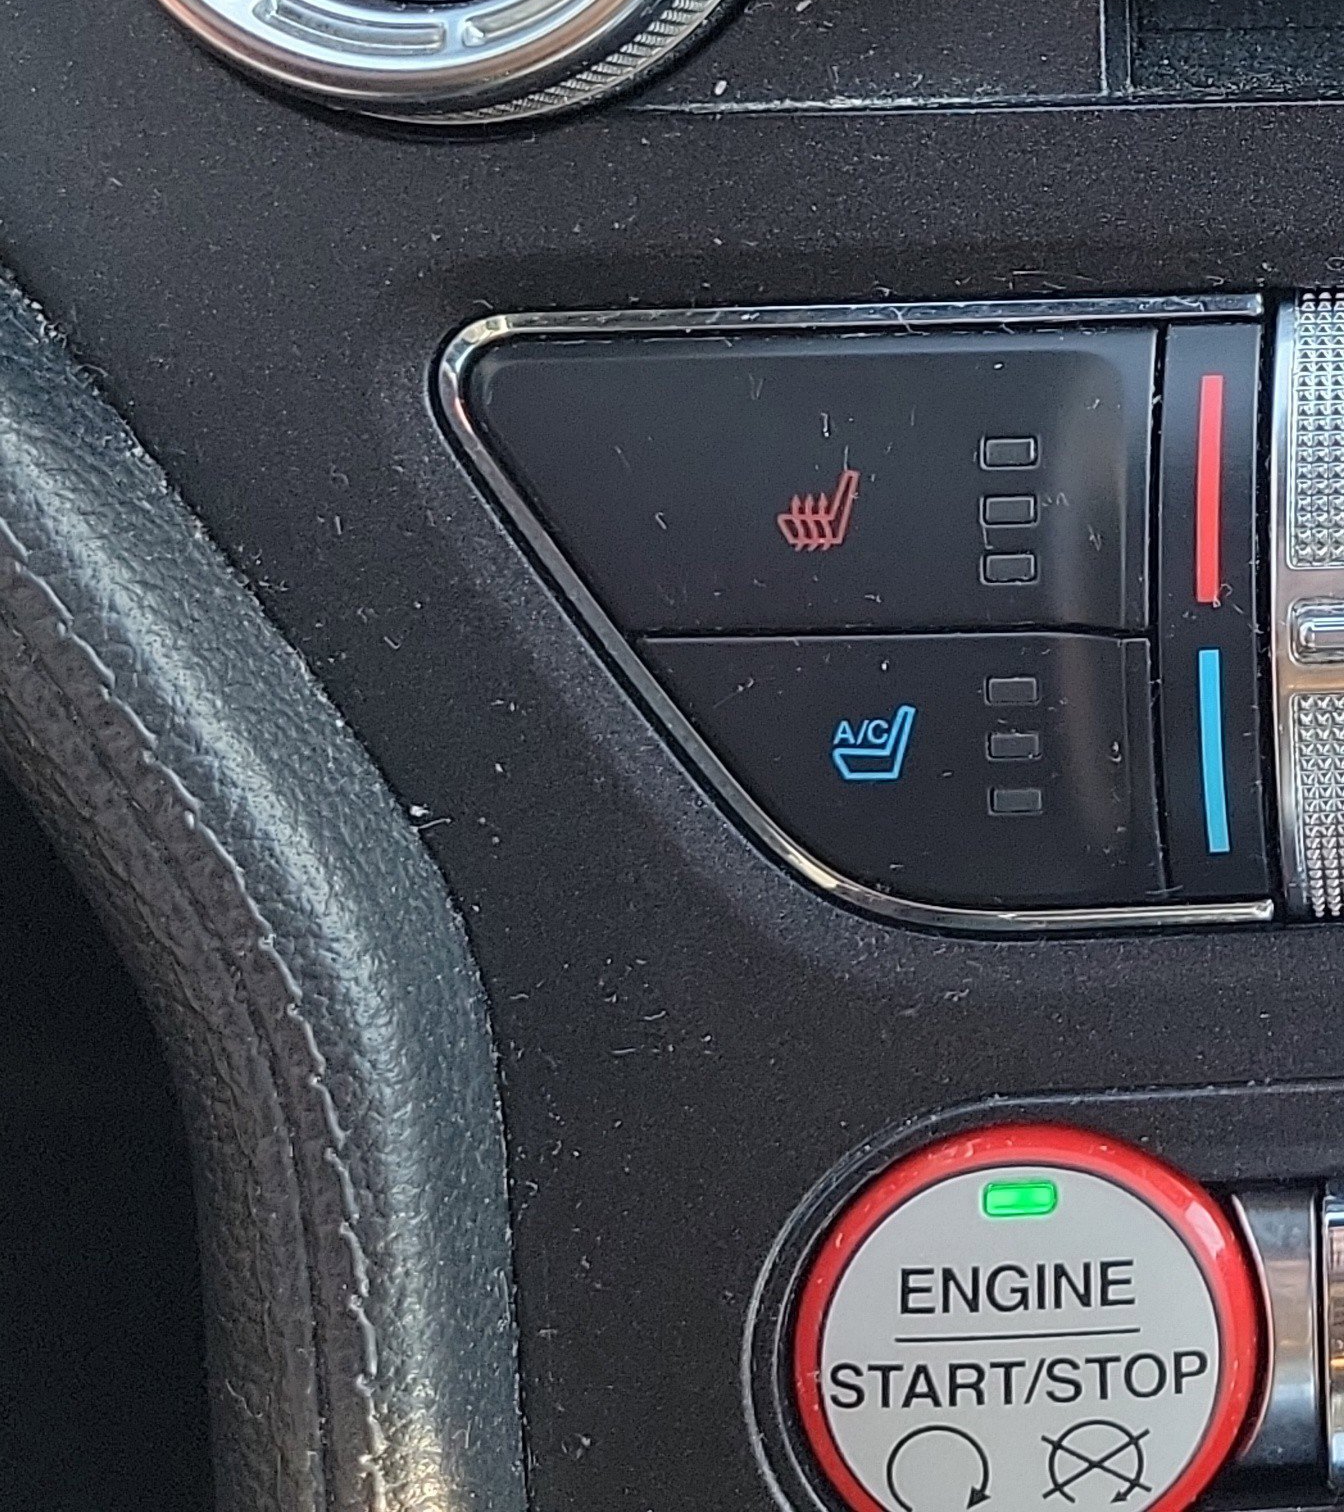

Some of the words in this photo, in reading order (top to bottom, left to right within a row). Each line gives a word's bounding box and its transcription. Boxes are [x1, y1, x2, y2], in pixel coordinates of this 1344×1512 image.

[833, 718, 890, 746] A/C
[900, 1259, 1136, 1315] ENGINE
[829, 1350, 1209, 1410] START/STOP
